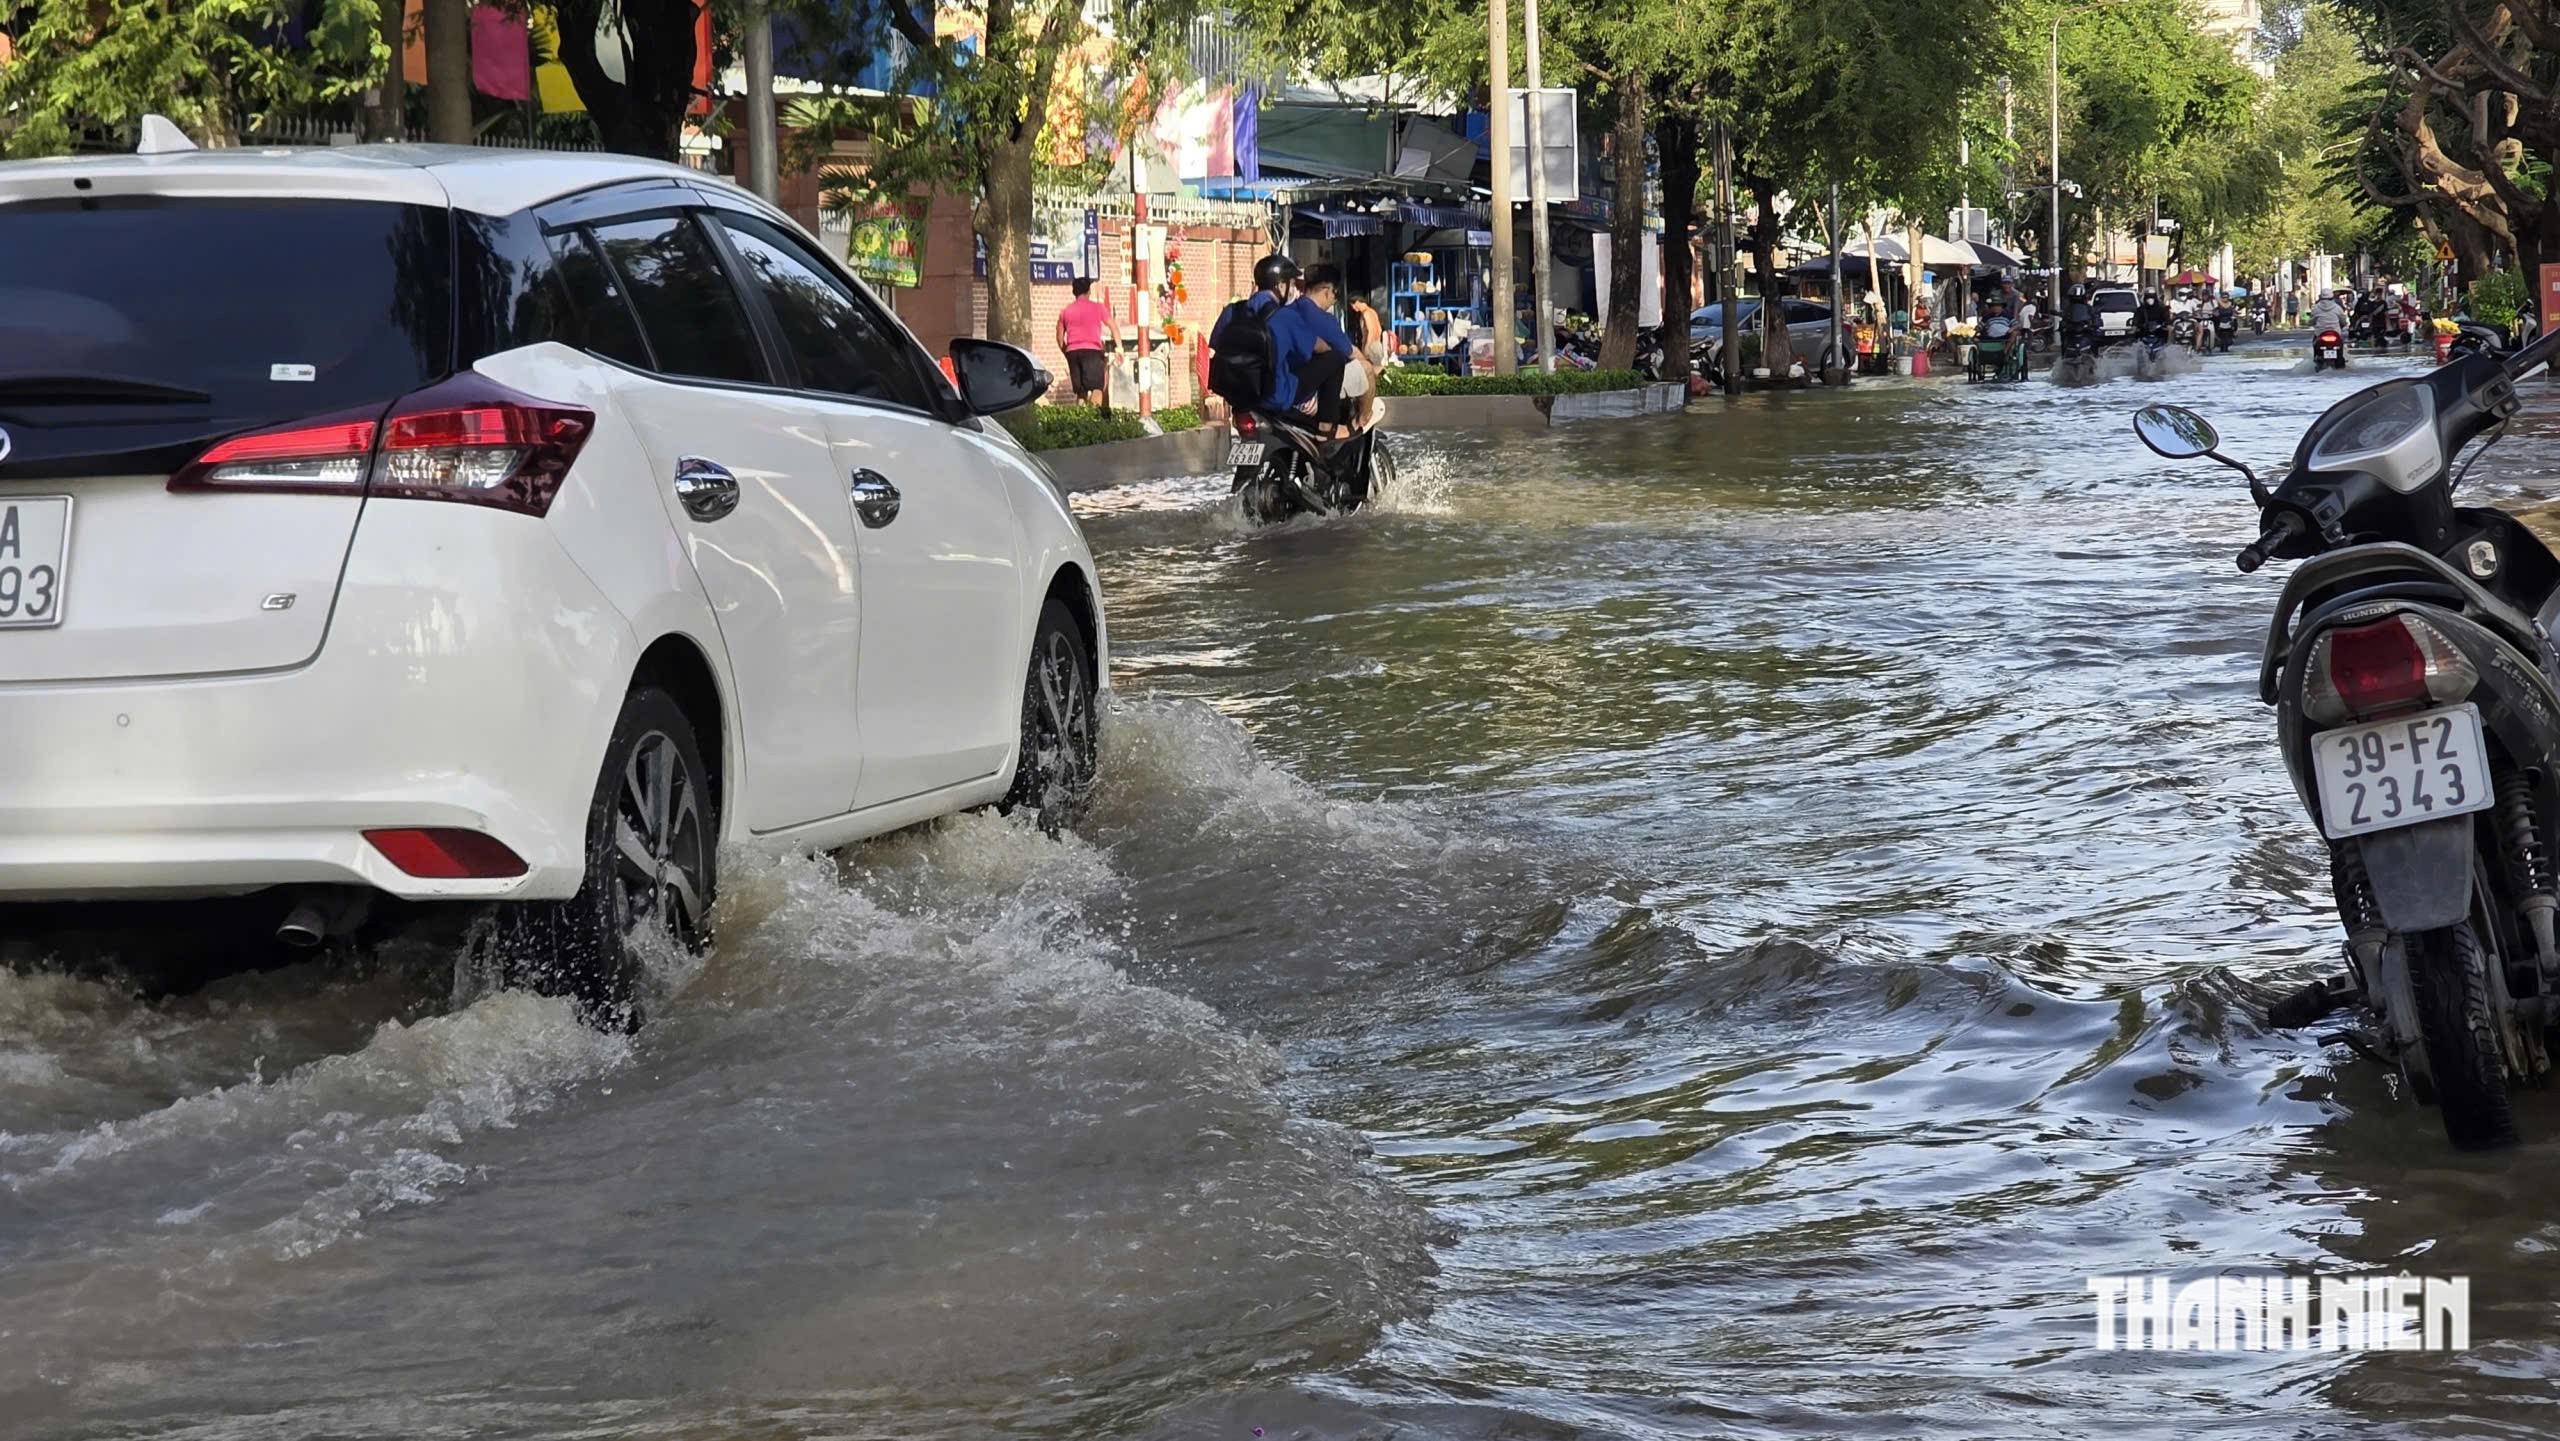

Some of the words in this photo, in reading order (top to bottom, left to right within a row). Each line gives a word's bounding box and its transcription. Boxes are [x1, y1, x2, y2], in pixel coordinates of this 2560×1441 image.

[889, 239, 916, 258] 10K
[2342, 607, 2386, 621] HONDA
[2338, 717, 2458, 778] 39-F2
[2346, 763, 2466, 826] 2343
